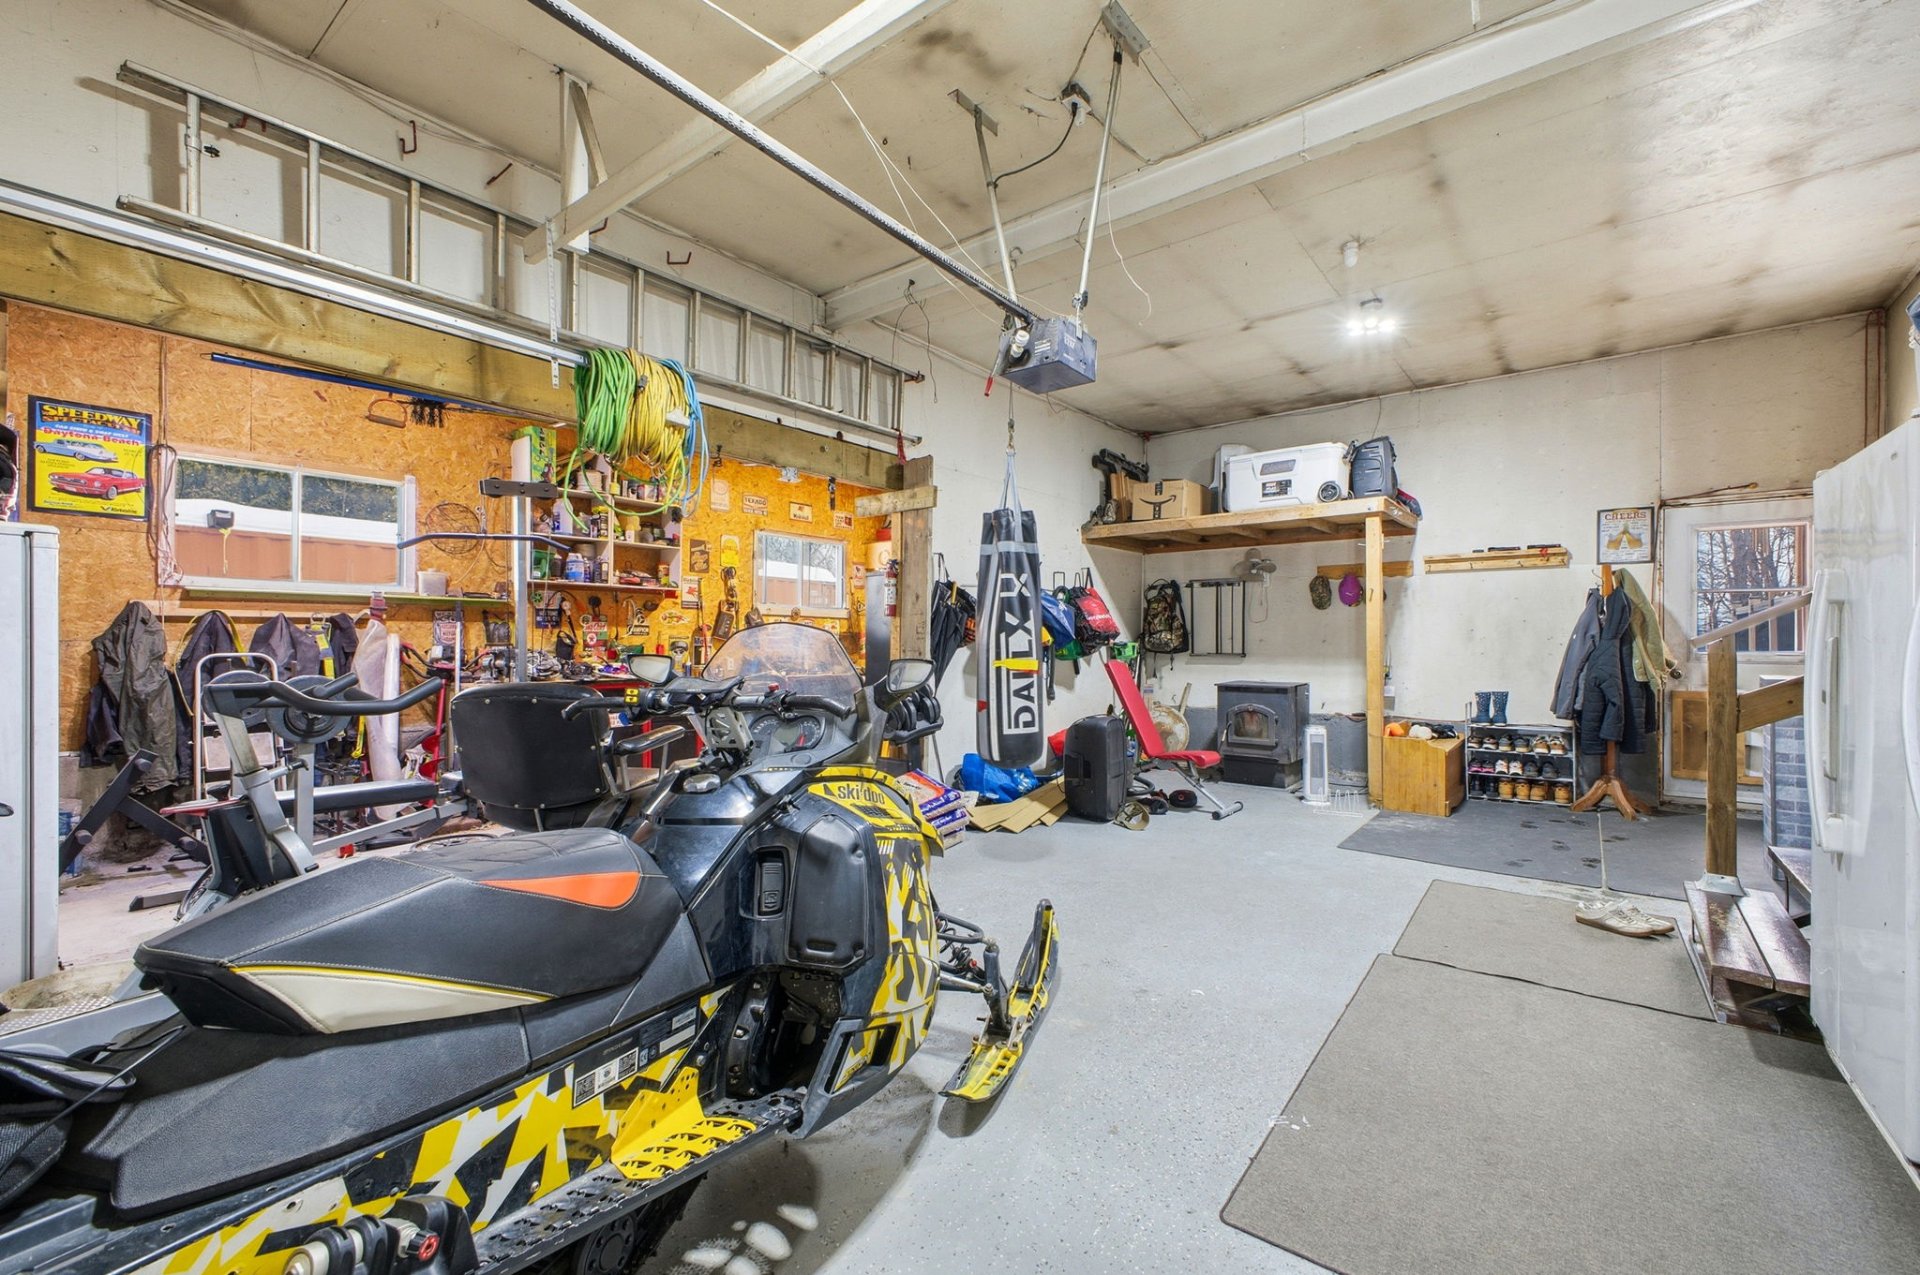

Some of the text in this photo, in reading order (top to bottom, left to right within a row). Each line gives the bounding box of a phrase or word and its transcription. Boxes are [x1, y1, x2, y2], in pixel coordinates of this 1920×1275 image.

[43, 405, 140, 429] SPEEDWAY
[44, 427, 139, 446] Daytona Beach
[1605, 511, 1647, 520] CHEERS
